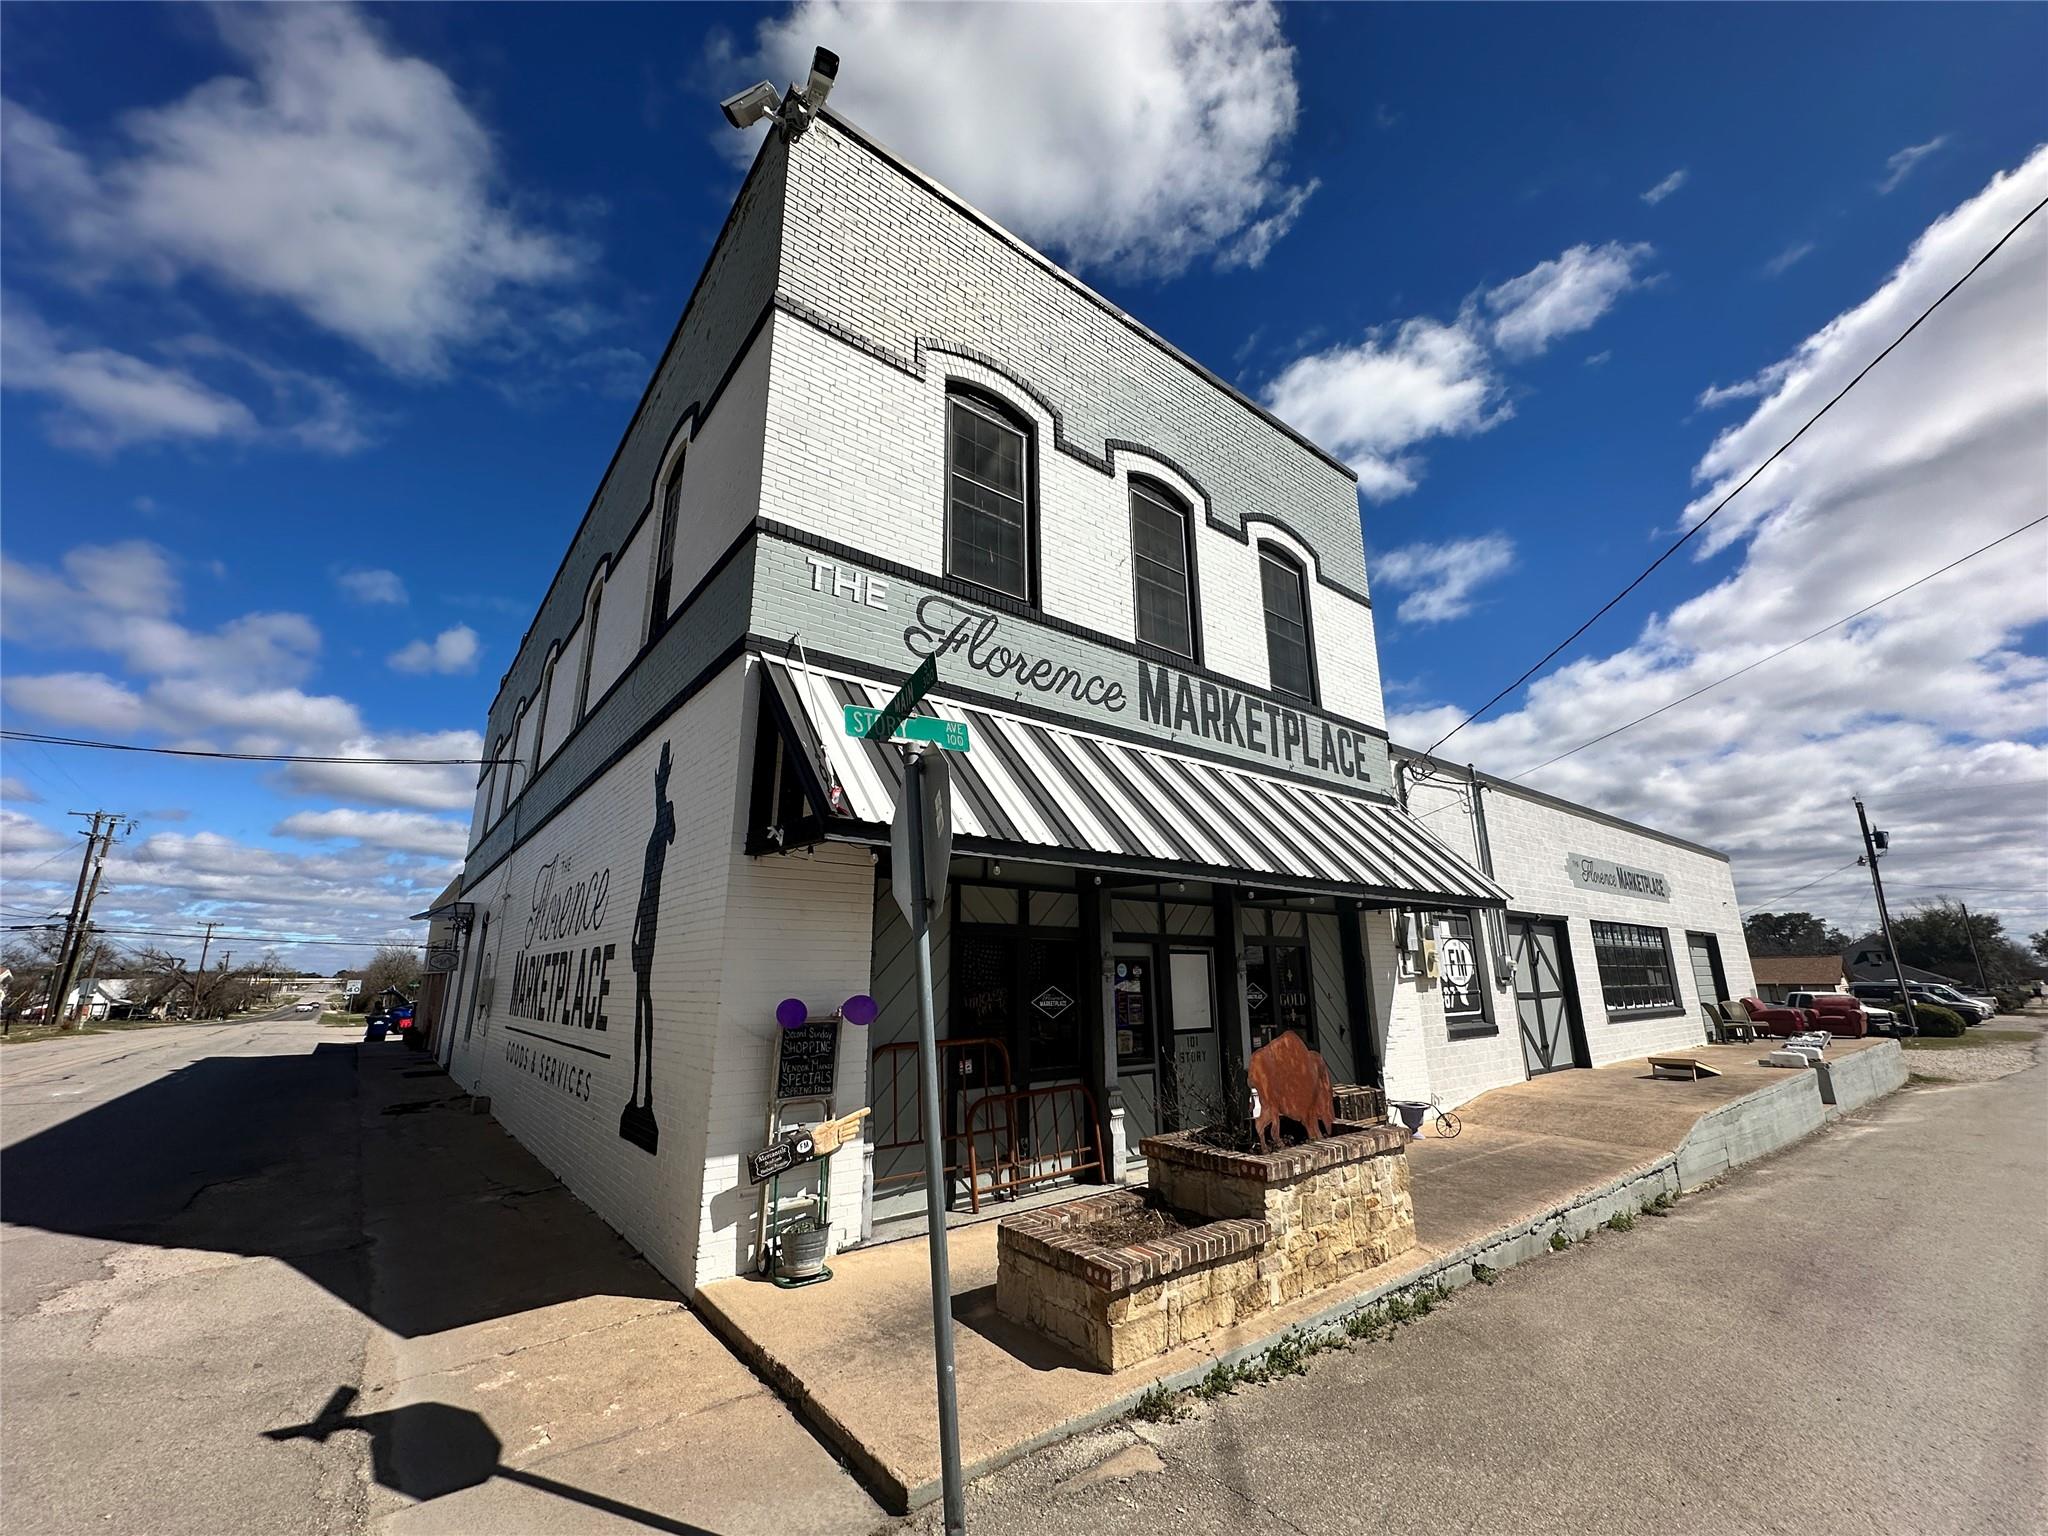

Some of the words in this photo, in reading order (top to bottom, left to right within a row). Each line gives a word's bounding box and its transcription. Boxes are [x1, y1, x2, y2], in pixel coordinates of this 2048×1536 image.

[806, 556, 890, 612] THE
[903, 595, 1128, 713] Florence
[1138, 660, 1371, 783] MARKETPLACE
[894, 681, 915, 712] MAIN
[853, 711, 907, 738] STORY
[946, 722, 962, 735] AVE
[946, 734, 964, 746] 100
[560, 857, 572, 874] THE
[1581, 859, 1617, 887] Florence
[1616, 866, 1666, 897] MARKETPLACE
[524, 853, 610, 949] Florence
[1447, 949, 1468, 976] FM
[509, 943, 616, 1031] MARKETPLACE
[1280, 993, 1306, 1007] GOLD
[809, 1027, 833, 1040] Sunday
[1187, 1036, 1199, 1048] 101
[783, 1040, 832, 1054] SHOPPING
[1180, 1051, 1207, 1064] STORY
[506, 1040, 530, 1071] GOODS
[531, 1050, 537, 1073] &
[539, 1053, 592, 1102] SERVICES
[781, 1071, 832, 1087] SPECIALS
[799, 1141, 809, 1151] FM
